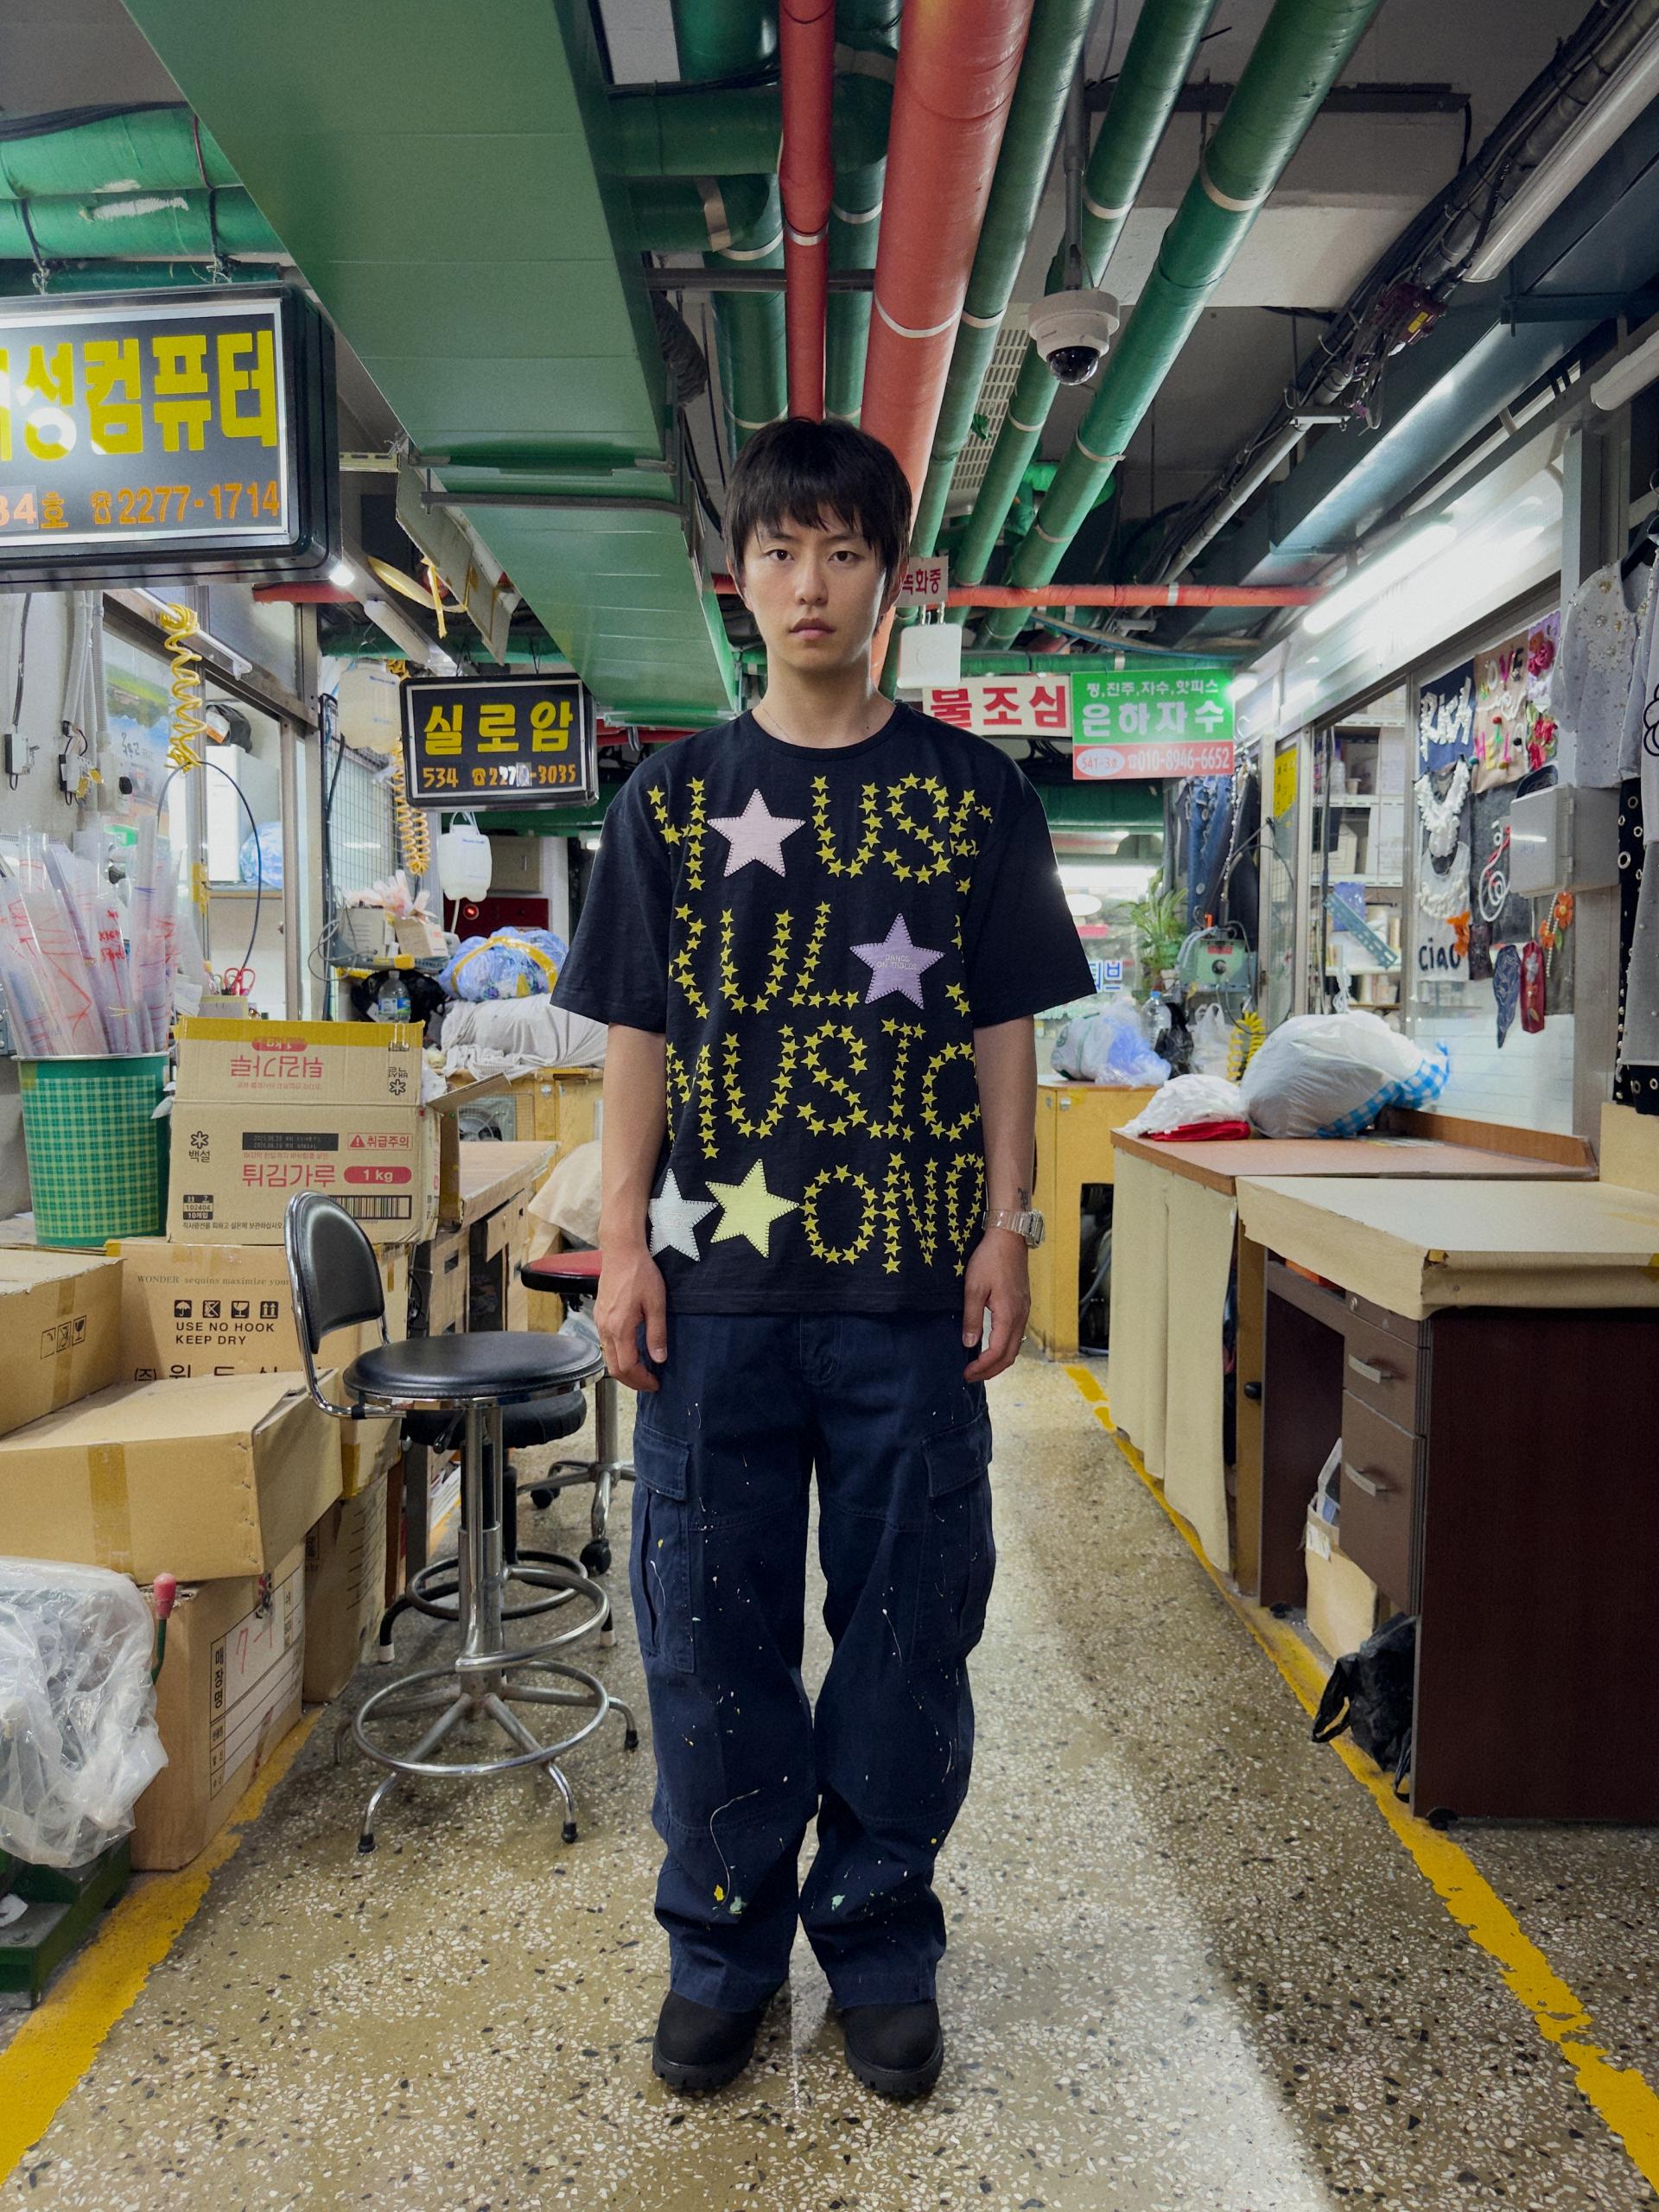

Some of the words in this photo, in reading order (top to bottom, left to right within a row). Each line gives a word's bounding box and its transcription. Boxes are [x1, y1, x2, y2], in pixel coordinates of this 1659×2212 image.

[0, 330, 277, 461] 성컴퓨터
[118, 480, 281, 524] 2277-1714
[930, 685, 1067, 730] 불조심
[1082, 700, 1225, 737] 은하자수
[423, 701, 574, 755] 실로암
[423, 766, 459, 788] 534
[230, 1054, 325, 1077] 튀김가루
[367, 1135, 410, 1148] 취급주의
[188, 1150, 211, 1163] 백설
[242, 1164, 336, 1188] 튀김가루
[363, 1169, 370, 1181] 1
[375, 1169, 394, 1183] kg
[137, 1275, 180, 1284] WONDER
[185, 1277, 220, 1286] sequins
[222, 1277, 266, 1286] maximize
[176, 1322, 203, 1332] USE
[209, 1323, 228, 1332] NO
[234, 1323, 275, 1332] HOOK
[175, 1335, 212, 1344] KEEP
[218, 1336, 246, 1345] DRY
